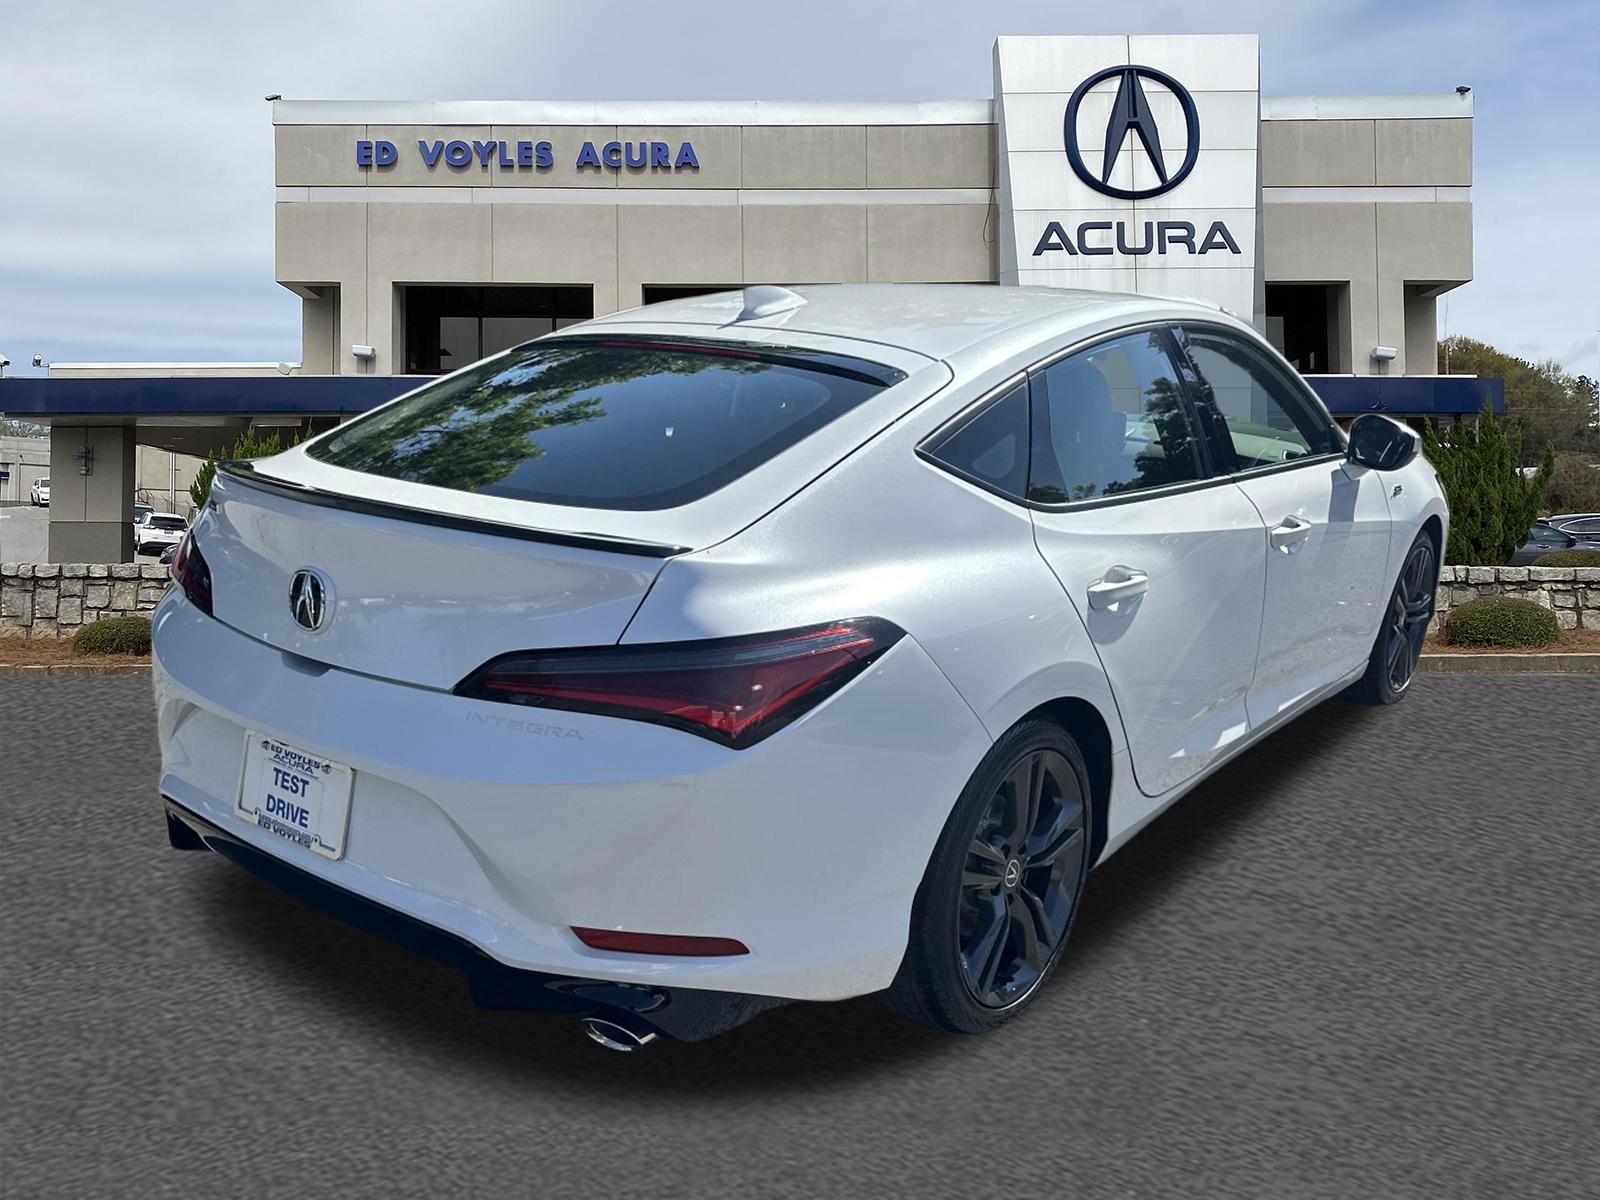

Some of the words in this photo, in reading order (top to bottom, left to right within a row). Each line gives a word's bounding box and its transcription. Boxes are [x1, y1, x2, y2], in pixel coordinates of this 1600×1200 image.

[356, 140, 398, 167] ED
[418, 140, 554, 168] VOYLES
[576, 141, 700, 168] ACURA
[1032, 221, 1242, 256] ACURA
[465, 710, 584, 741] INTEGRA
[270, 744, 283, 754] ED
[284, 749, 321, 769] VOYLES
[273, 753, 314, 775] ACURA
[273, 766, 310, 798] TEST
[266, 793, 310, 829] DRIVE
[257, 819, 271, 830] ED
[273, 825, 311, 849] VOYLES
